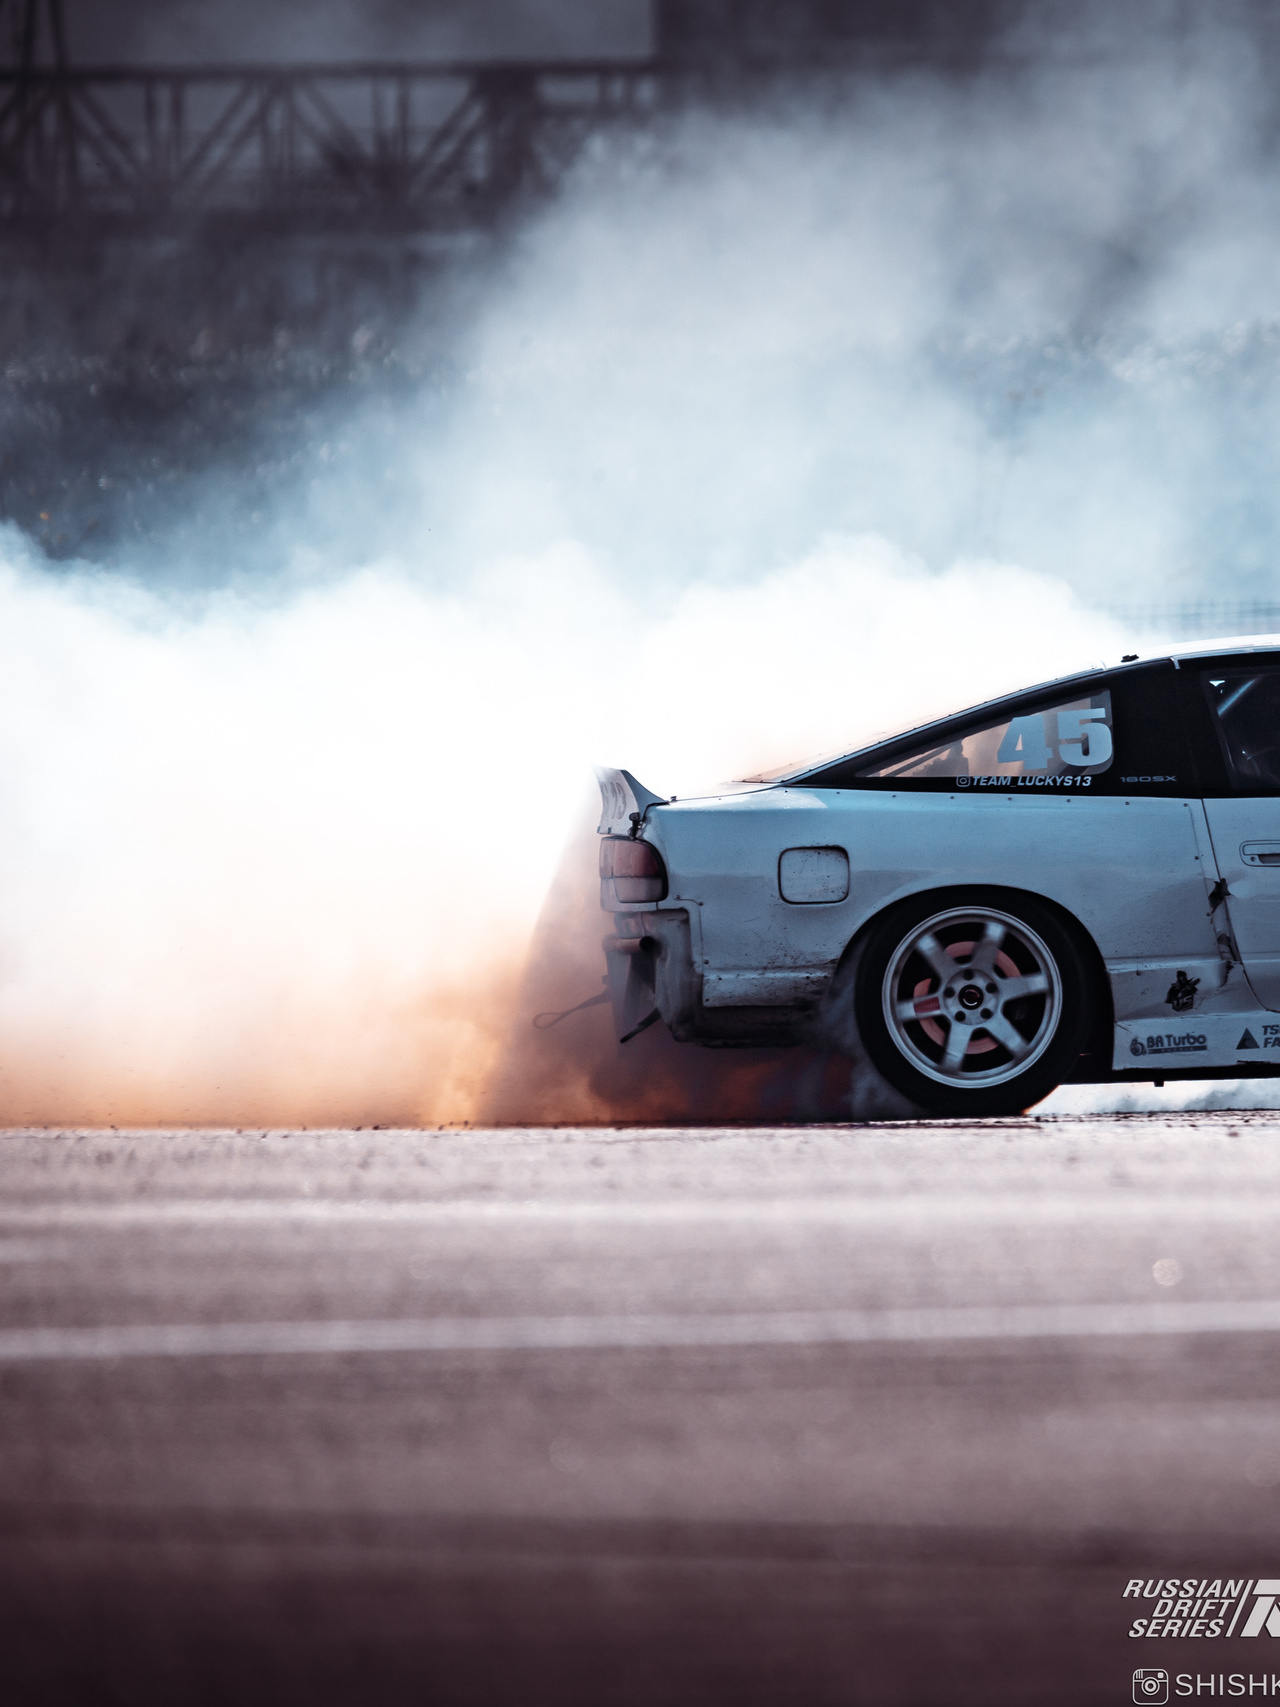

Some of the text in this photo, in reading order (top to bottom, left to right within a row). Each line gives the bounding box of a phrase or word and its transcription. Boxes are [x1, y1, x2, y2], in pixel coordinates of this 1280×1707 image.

[997, 708, 1113, 770] 45
[972, 775, 1092, 788] TEAM_LUCKYS13
[1165, 1032, 1207, 1047] Turbo
